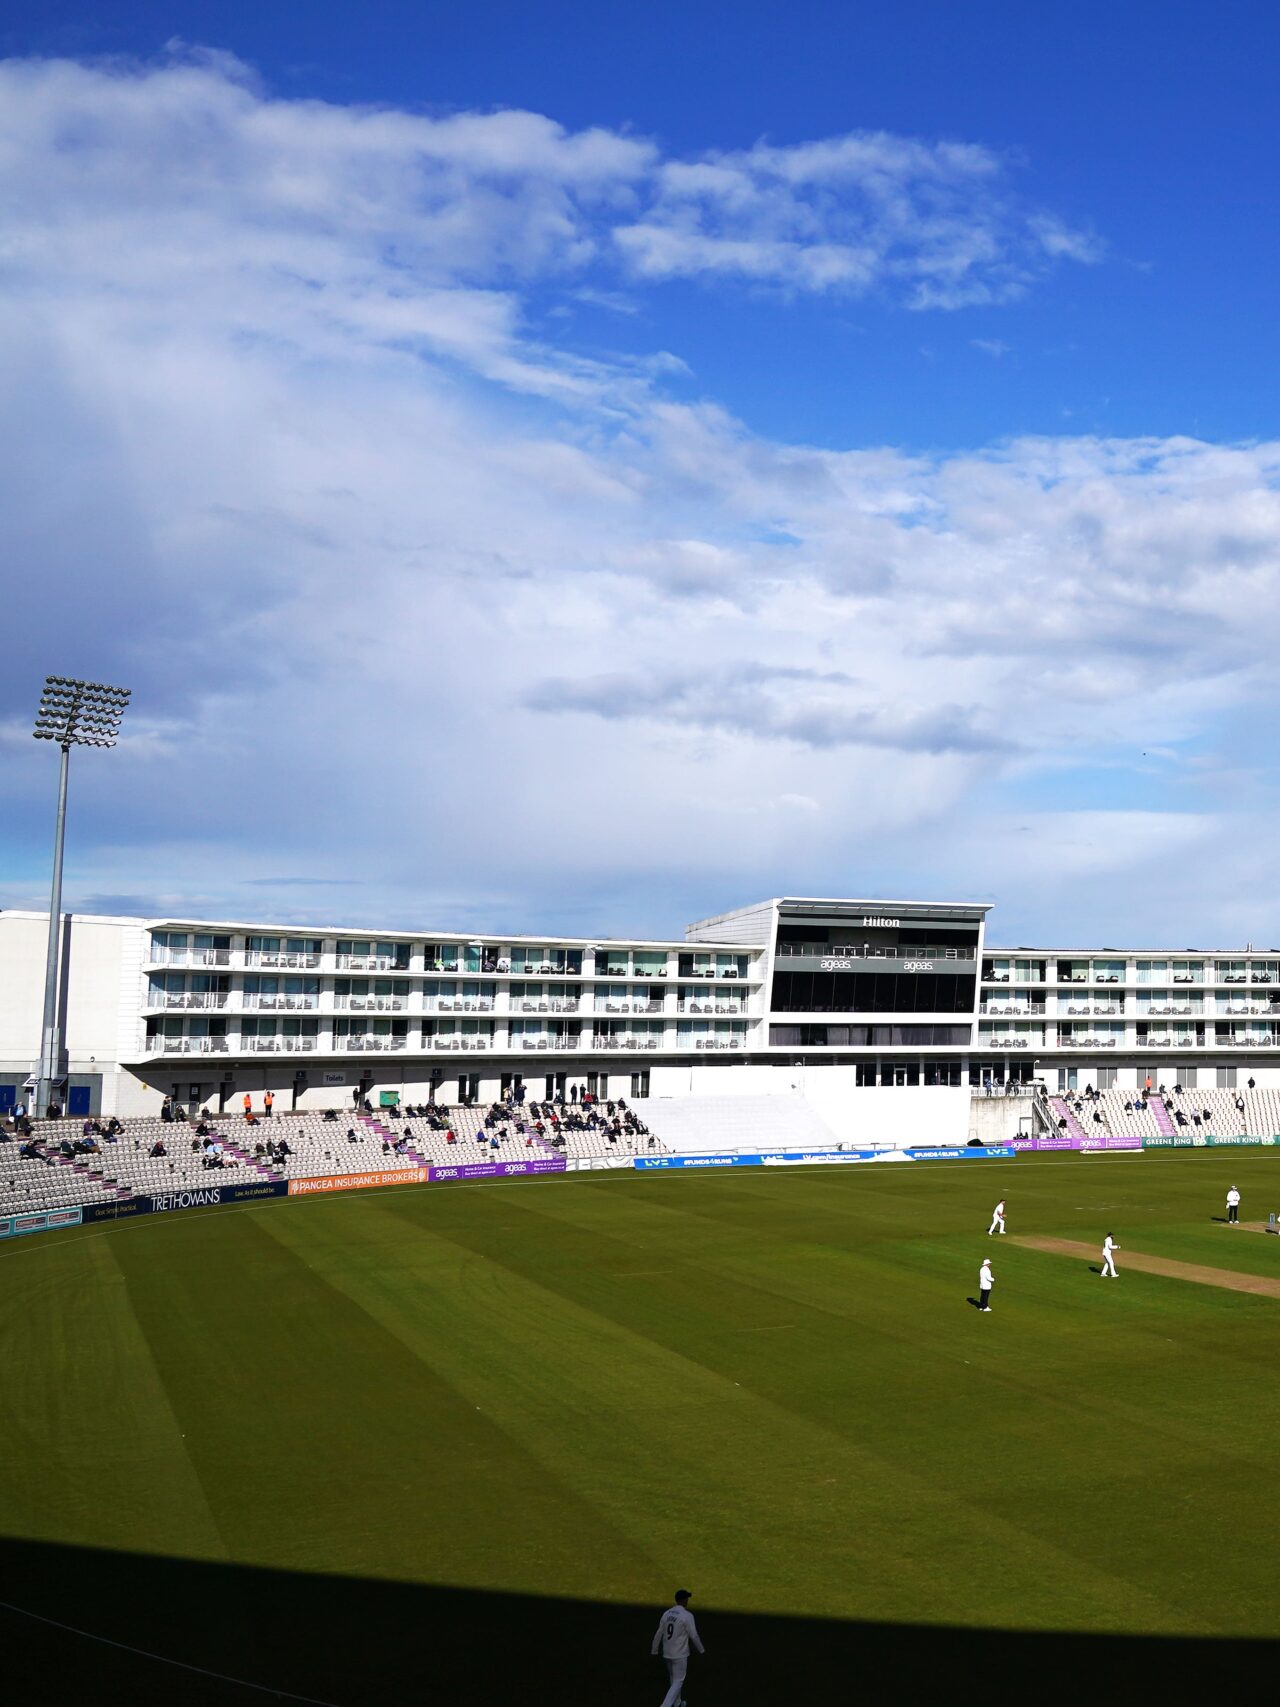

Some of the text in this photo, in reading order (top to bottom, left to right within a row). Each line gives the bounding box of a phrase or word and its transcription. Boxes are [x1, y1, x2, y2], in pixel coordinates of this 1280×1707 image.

[863, 916, 900, 928] Hilton
[820, 960, 850, 972] ageas
[904, 961, 932, 972] ageas
[1011, 1141, 1032, 1150] ageas
[1080, 1139, 1101, 1148] ageas
[436, 1168, 458, 1180] ageas
[505, 1164, 527, 1174] ageas
[300, 1171, 418, 1190] PANGEA INSURANCE BROKERS
[151, 1189, 220, 1211] TRETHOWANS
[667, 1624, 674, 1640] 9
